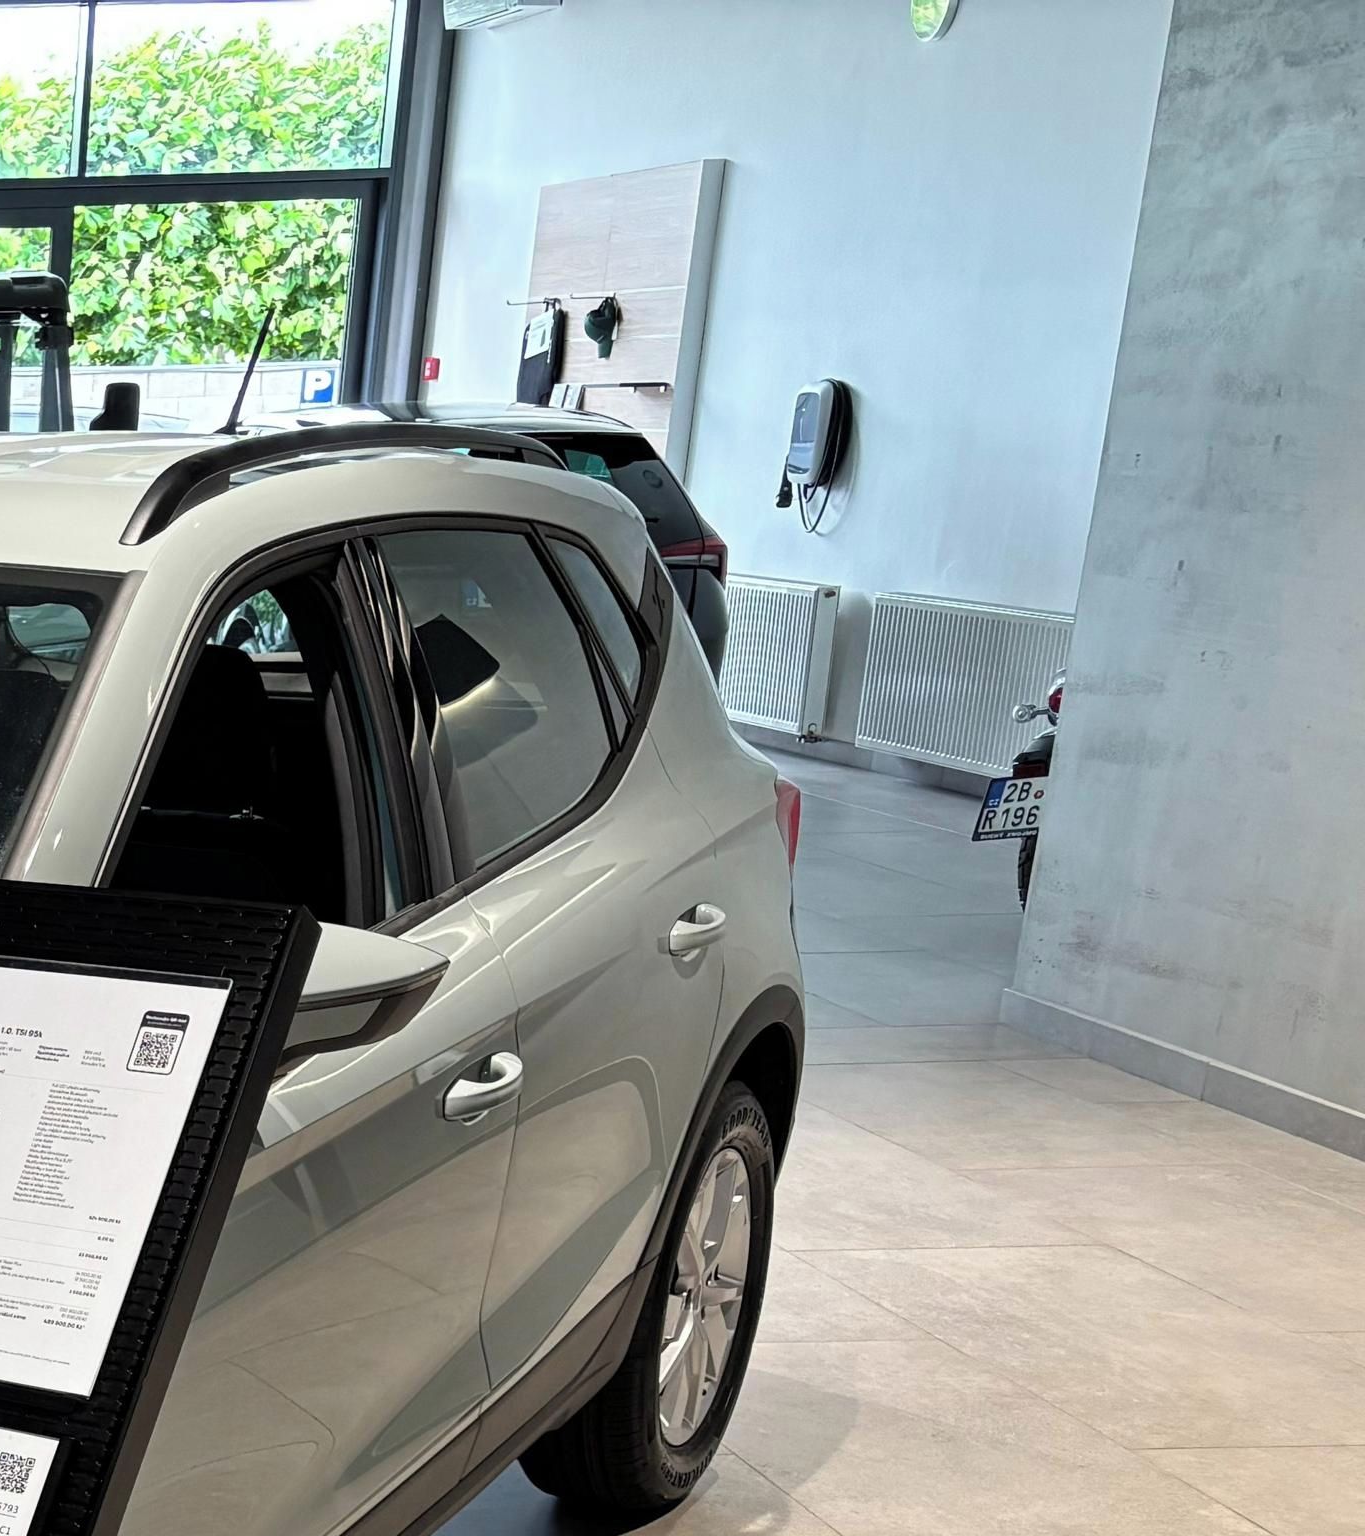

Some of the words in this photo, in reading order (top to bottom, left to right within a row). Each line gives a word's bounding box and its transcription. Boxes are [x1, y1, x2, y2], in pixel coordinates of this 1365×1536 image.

[1003, 781, 1032, 804] 2B
[15, 1028, 27, 1036] TSI
[0, 1525, 10, 1535] C1
